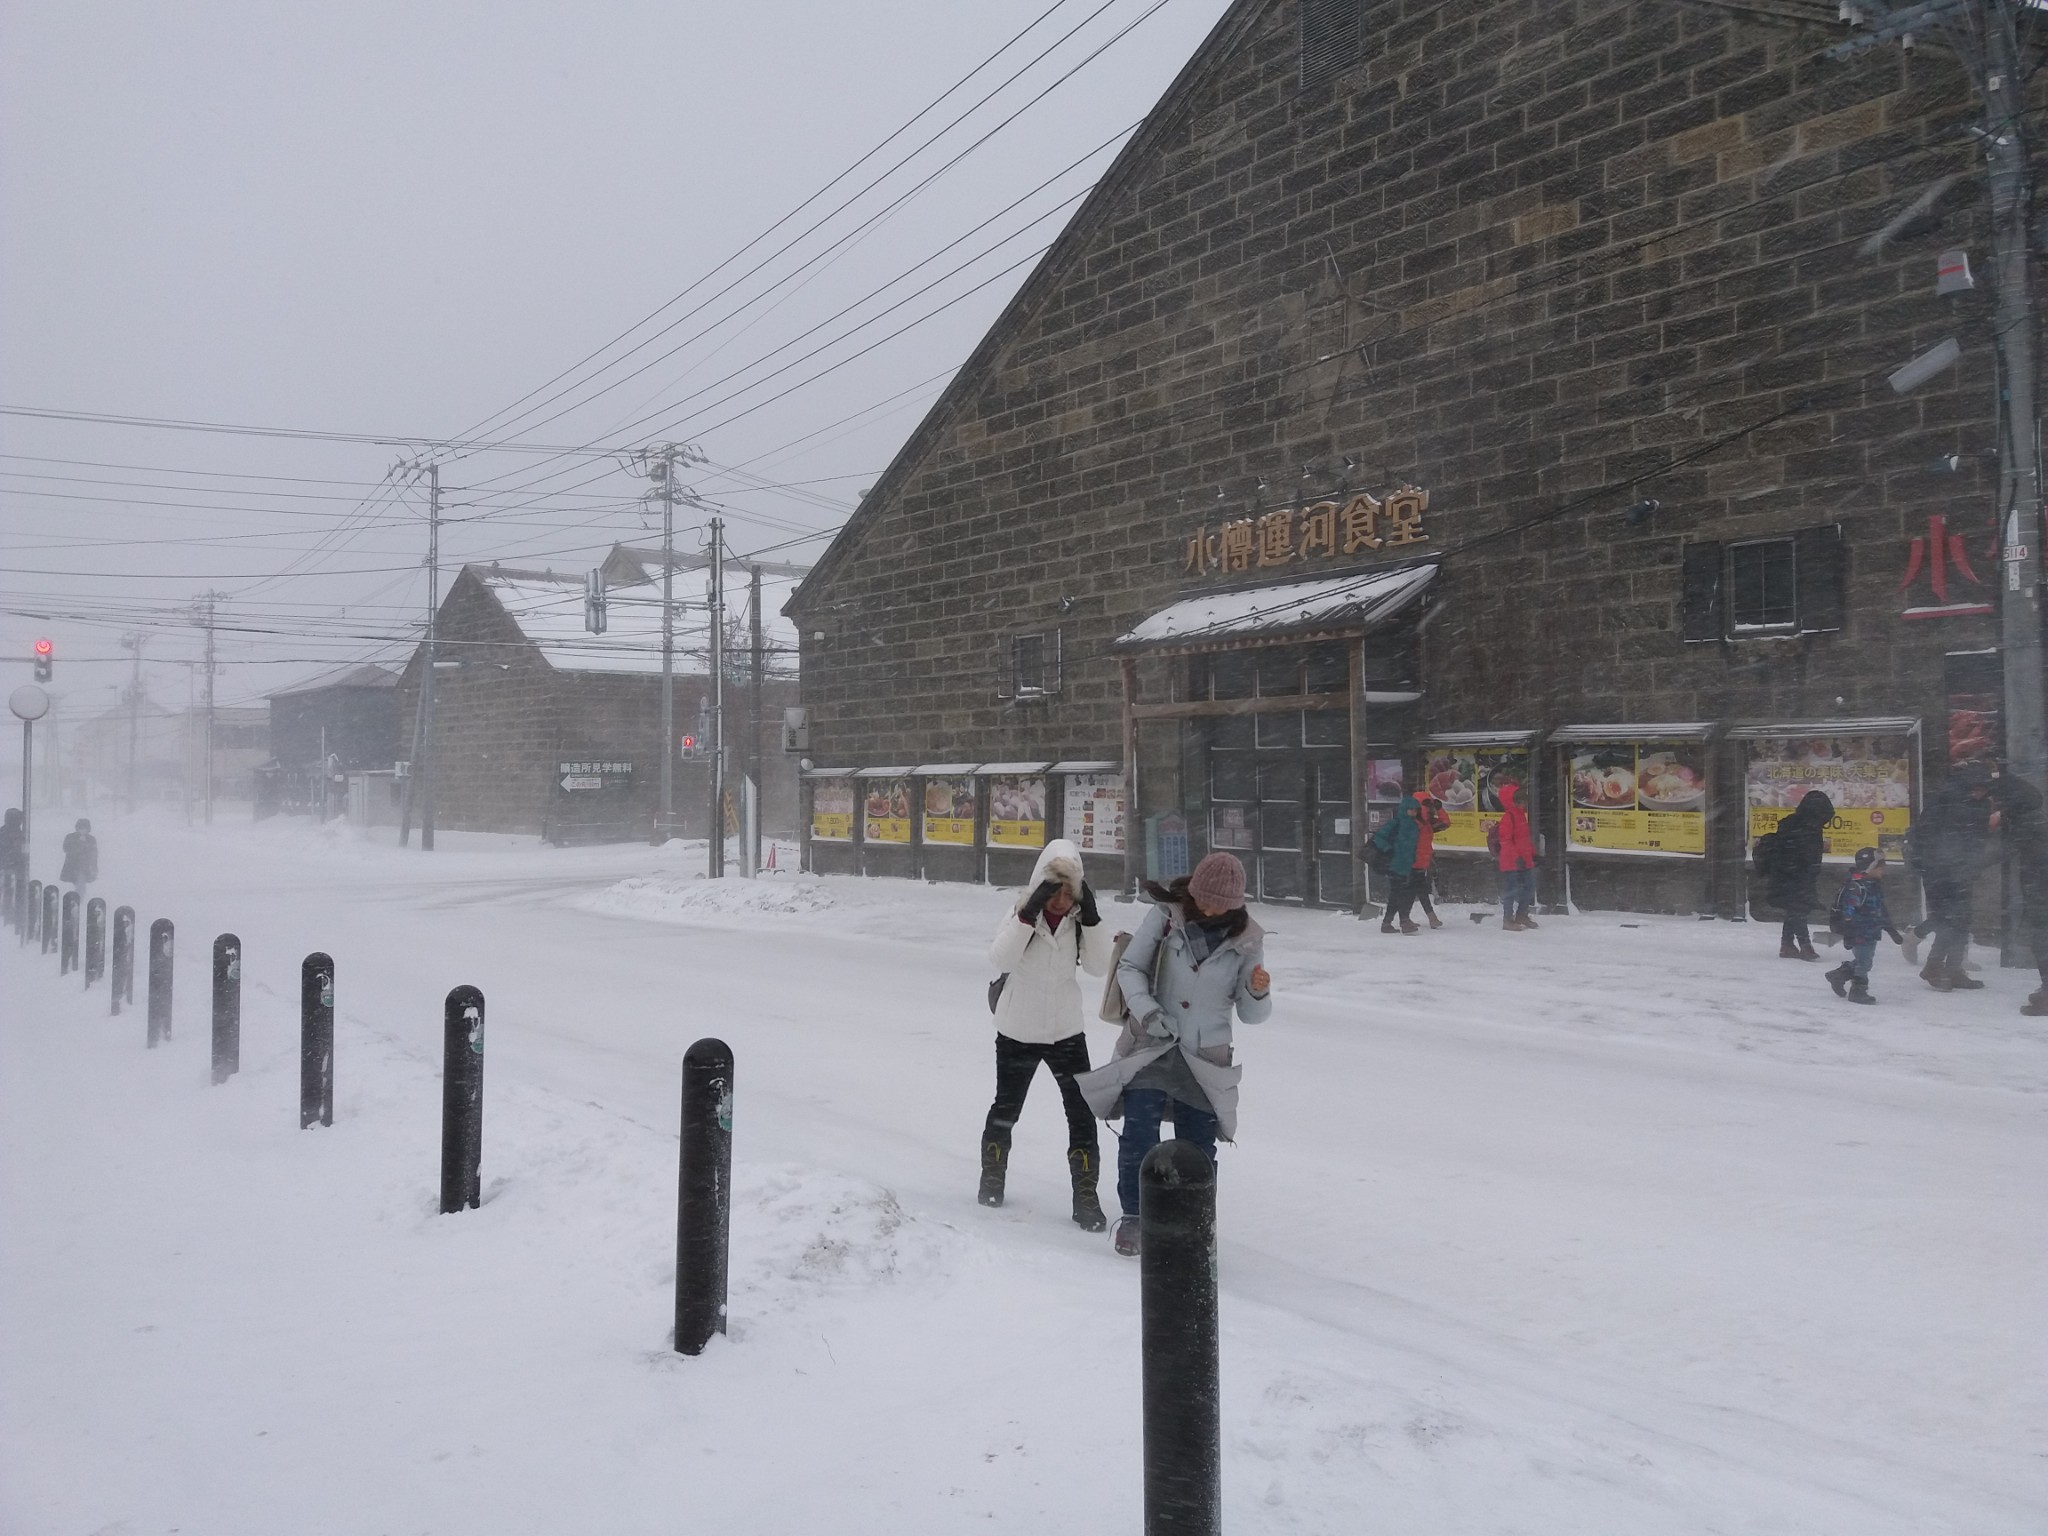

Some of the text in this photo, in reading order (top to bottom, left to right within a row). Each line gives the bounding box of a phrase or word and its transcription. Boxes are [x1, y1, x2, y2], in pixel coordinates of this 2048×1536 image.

[1185, 483, 1430, 577] 小樽運河食堂
[1767, 763, 1889, 779] 北海道の美味、大集合
[1752, 813, 1778, 822] 北海道
[1822, 815, 1853, 831] 00円
[1752, 821, 1777, 831] バイキ
